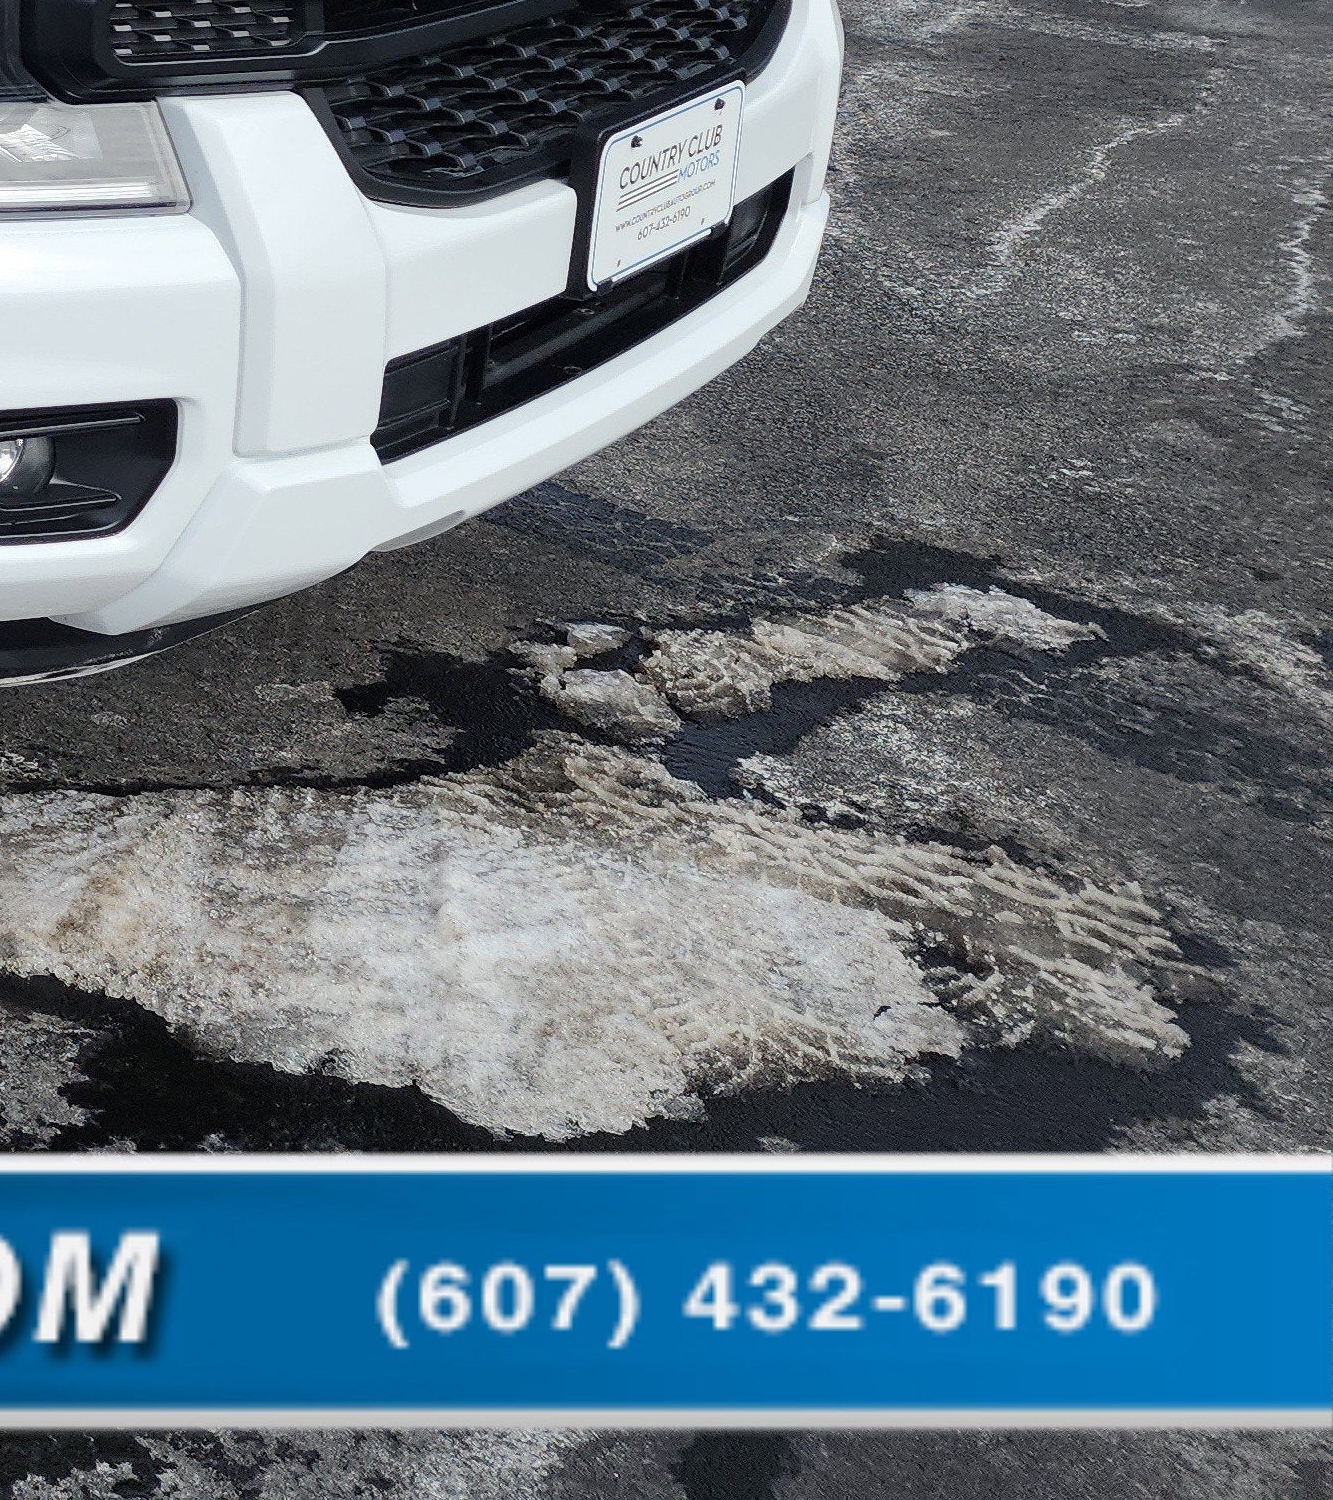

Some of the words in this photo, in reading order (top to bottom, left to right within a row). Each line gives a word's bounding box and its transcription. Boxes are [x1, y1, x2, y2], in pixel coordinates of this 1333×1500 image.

[619, 139, 689, 190] COUNTRY
[688, 124, 723, 159] CLUB
[677, 150, 720, 184] MOTORS
[636, 205, 692, 241] 607-432-6190
